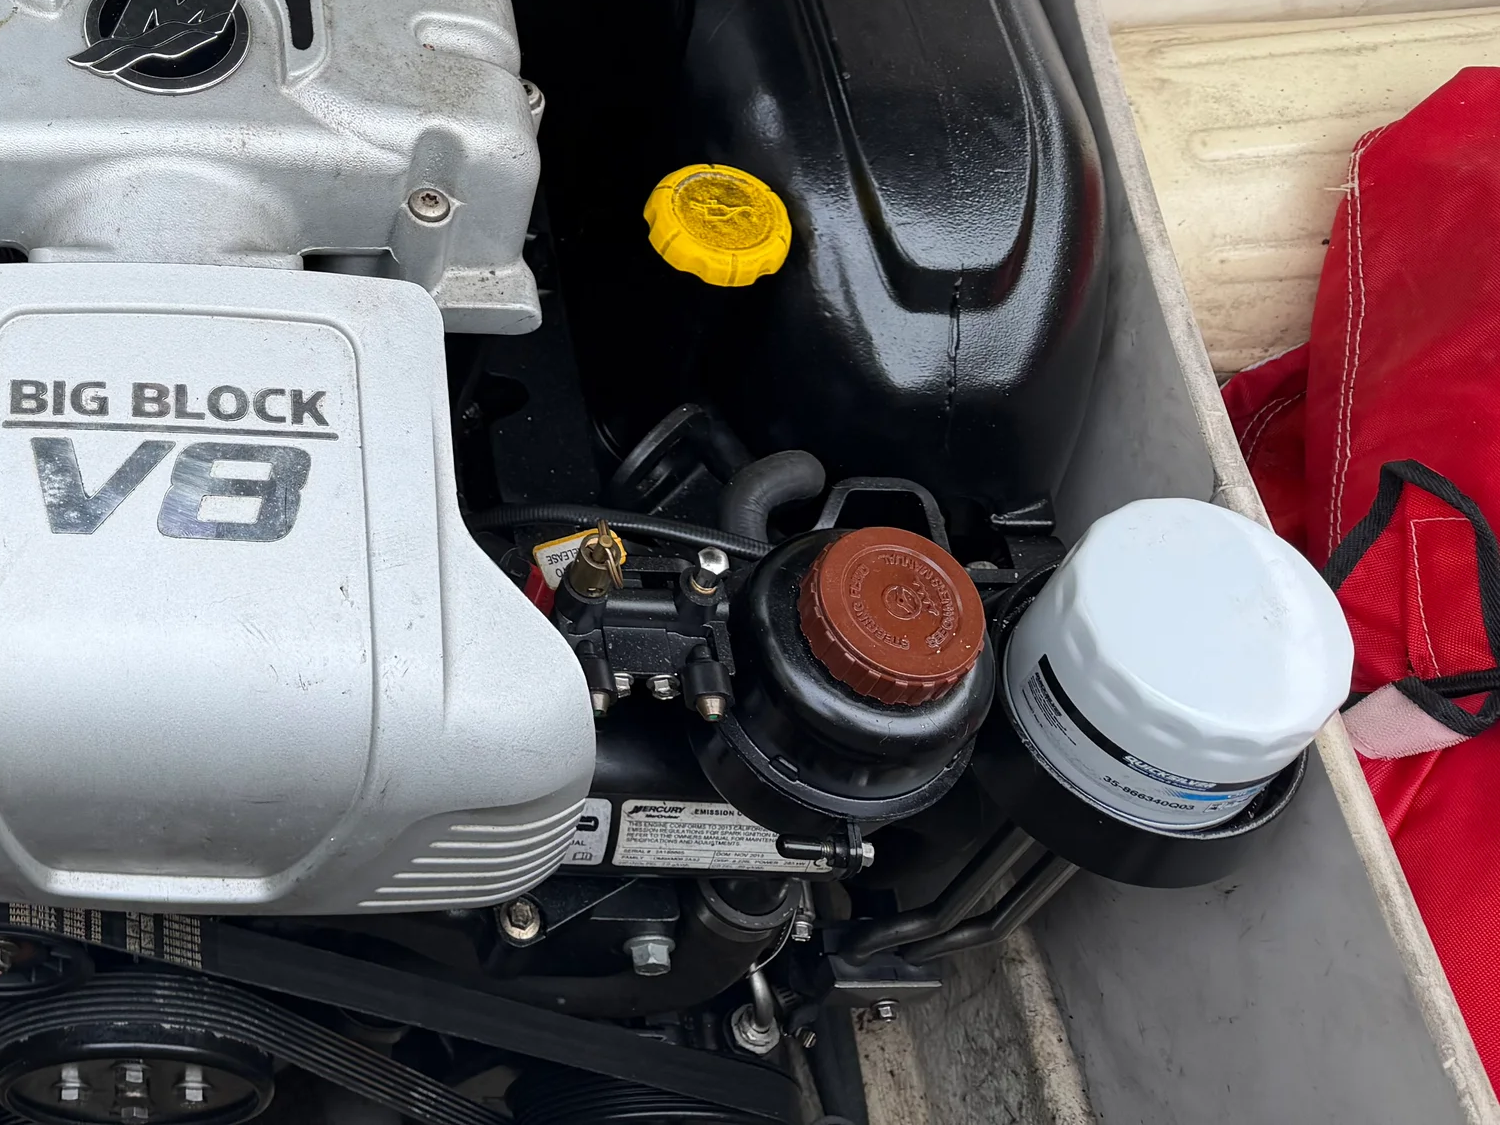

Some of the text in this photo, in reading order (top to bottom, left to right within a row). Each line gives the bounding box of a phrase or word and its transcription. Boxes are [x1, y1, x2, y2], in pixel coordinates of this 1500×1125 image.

[9, 379, 330, 427] BIG BLOCK
[30, 436, 312, 542] V8
[879, 554, 933, 578] MANUAL
[850, 564, 910, 650] STEERING FLUID
[925, 628, 950, 649] SEE
[1123, 755, 1217, 790] QUICKSILVER
[628, 805, 686, 814] MERCURY
[1102, 775, 1195, 811] 35-866340Q03
